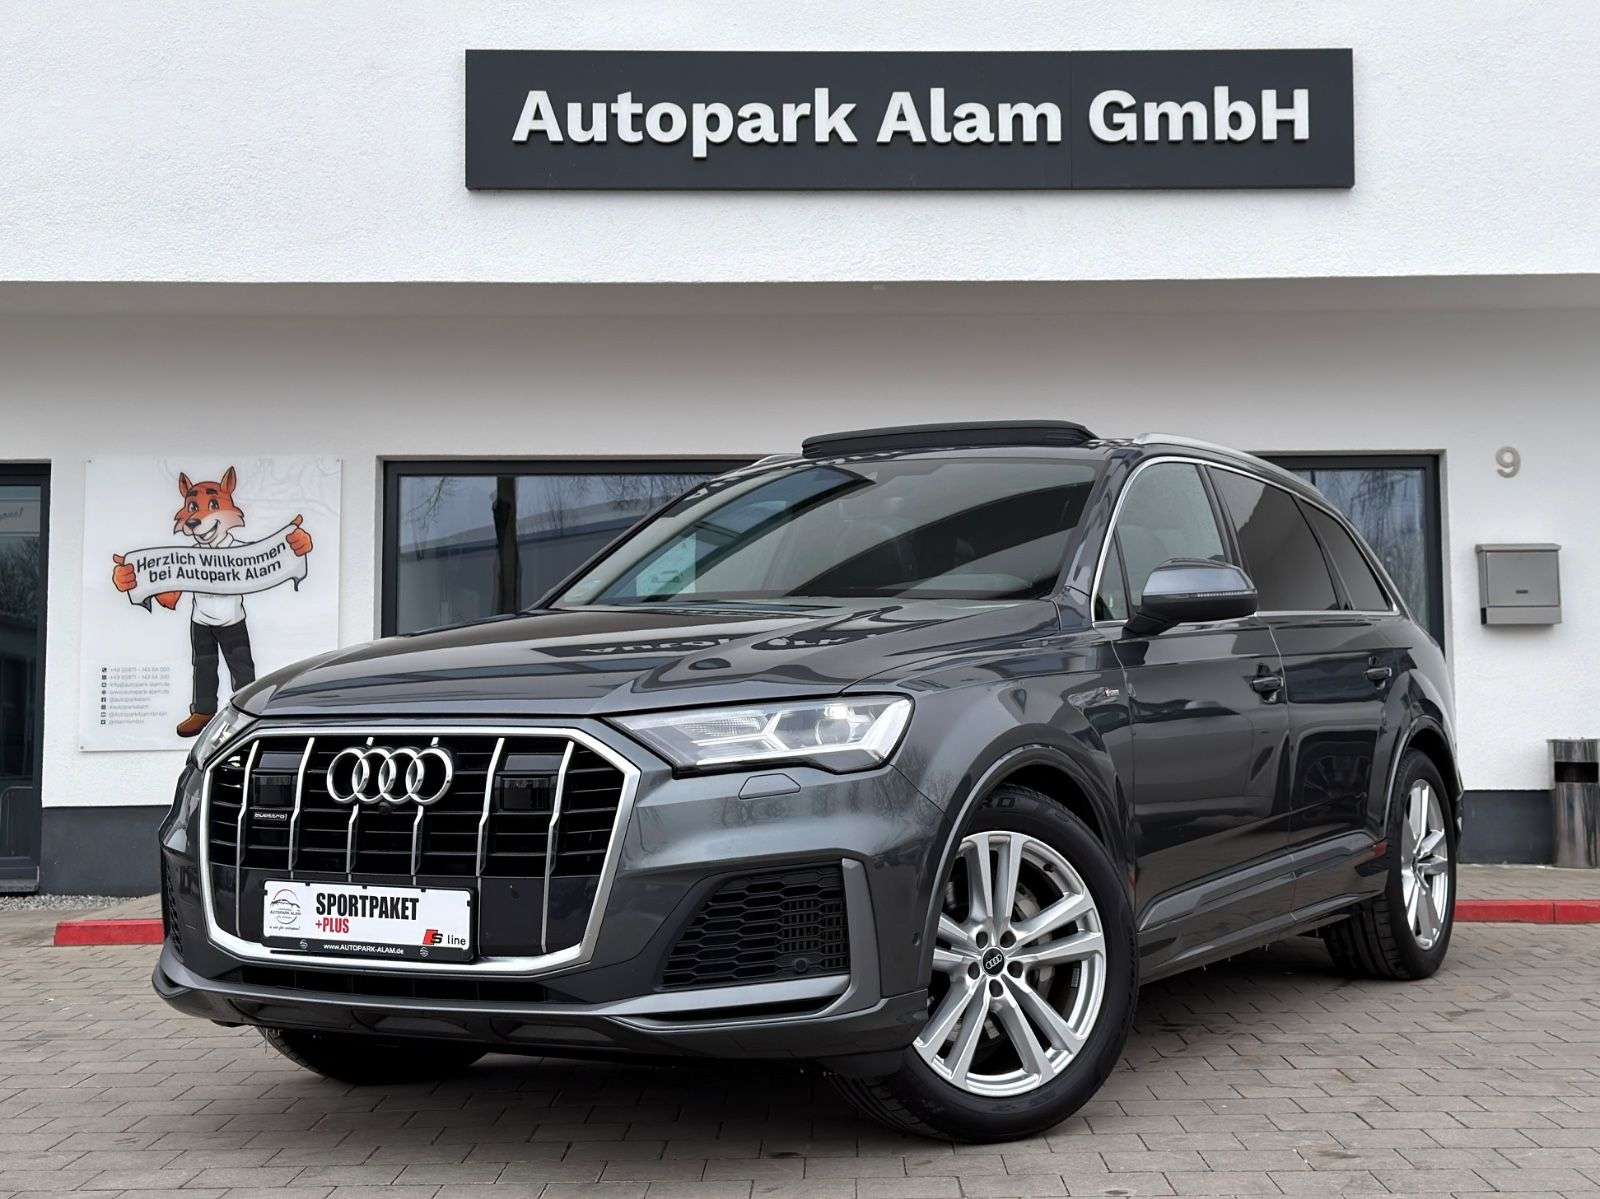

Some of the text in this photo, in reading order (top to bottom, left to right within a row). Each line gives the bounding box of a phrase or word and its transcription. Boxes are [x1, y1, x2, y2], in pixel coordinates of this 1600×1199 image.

[512, 86, 1311, 158] Autopark Alam GmbH
[1495, 446, 1521, 479] 9
[136, 541, 287, 573] Herzlich Willkommen
[149, 560, 282, 583] bei Autopark Alam
[315, 892, 419, 921] SPORTPAKET
[315, 917, 350, 934] +PLUS
[323, 943, 405, 955] www.AUTOPARK-ALAM.de
[447, 935, 467, 946] line
